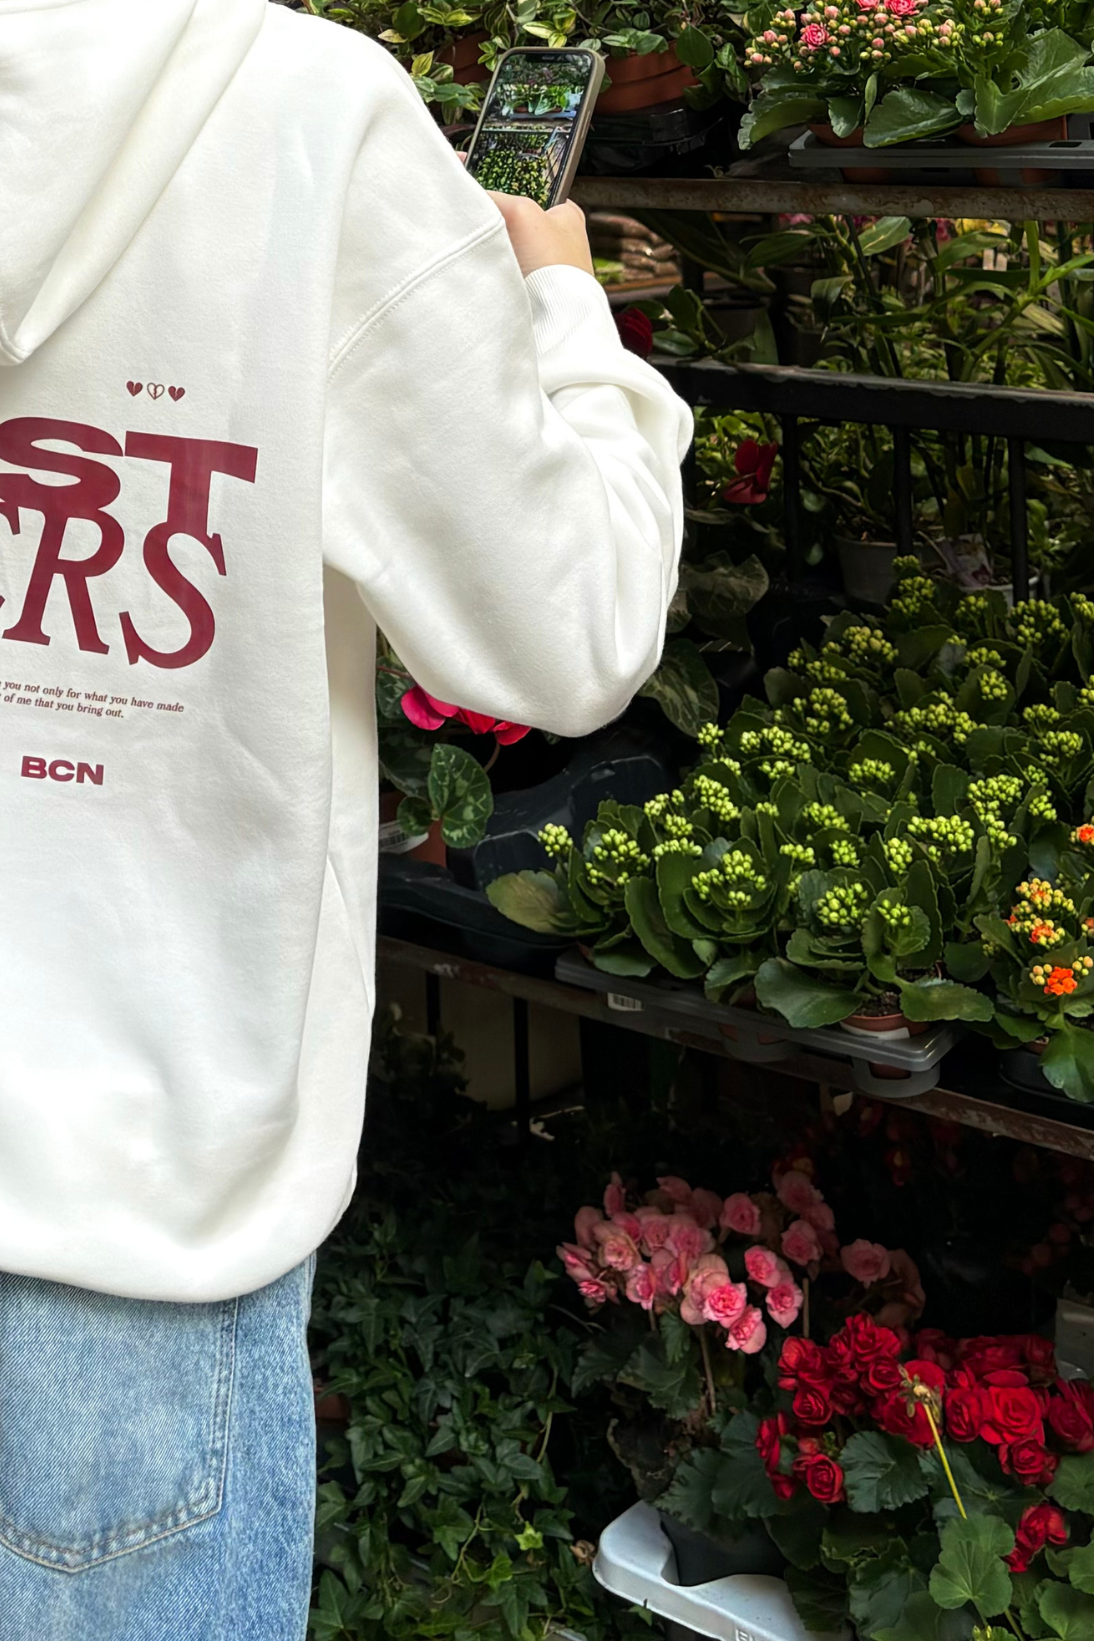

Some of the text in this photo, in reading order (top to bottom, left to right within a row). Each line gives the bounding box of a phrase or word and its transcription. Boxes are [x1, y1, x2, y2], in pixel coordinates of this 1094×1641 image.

[2, 681, 22, 692] you
[23, 684, 41, 694] not
[42, 685, 65, 699] only
[65, 687, 82, 700] for
[84, 691, 108, 704] what
[108, 695, 129, 706] you
[130, 696, 155, 710] have
[156, 702, 185, 714] made
[3, 692, 17, 704] of
[16, 696, 33, 706] me
[34, 697, 55, 709] that
[54, 702, 75, 712] you
[76, 702, 104, 718] bring
[105, 708, 124, 719] out.
[21, 755, 104, 786] BCN
